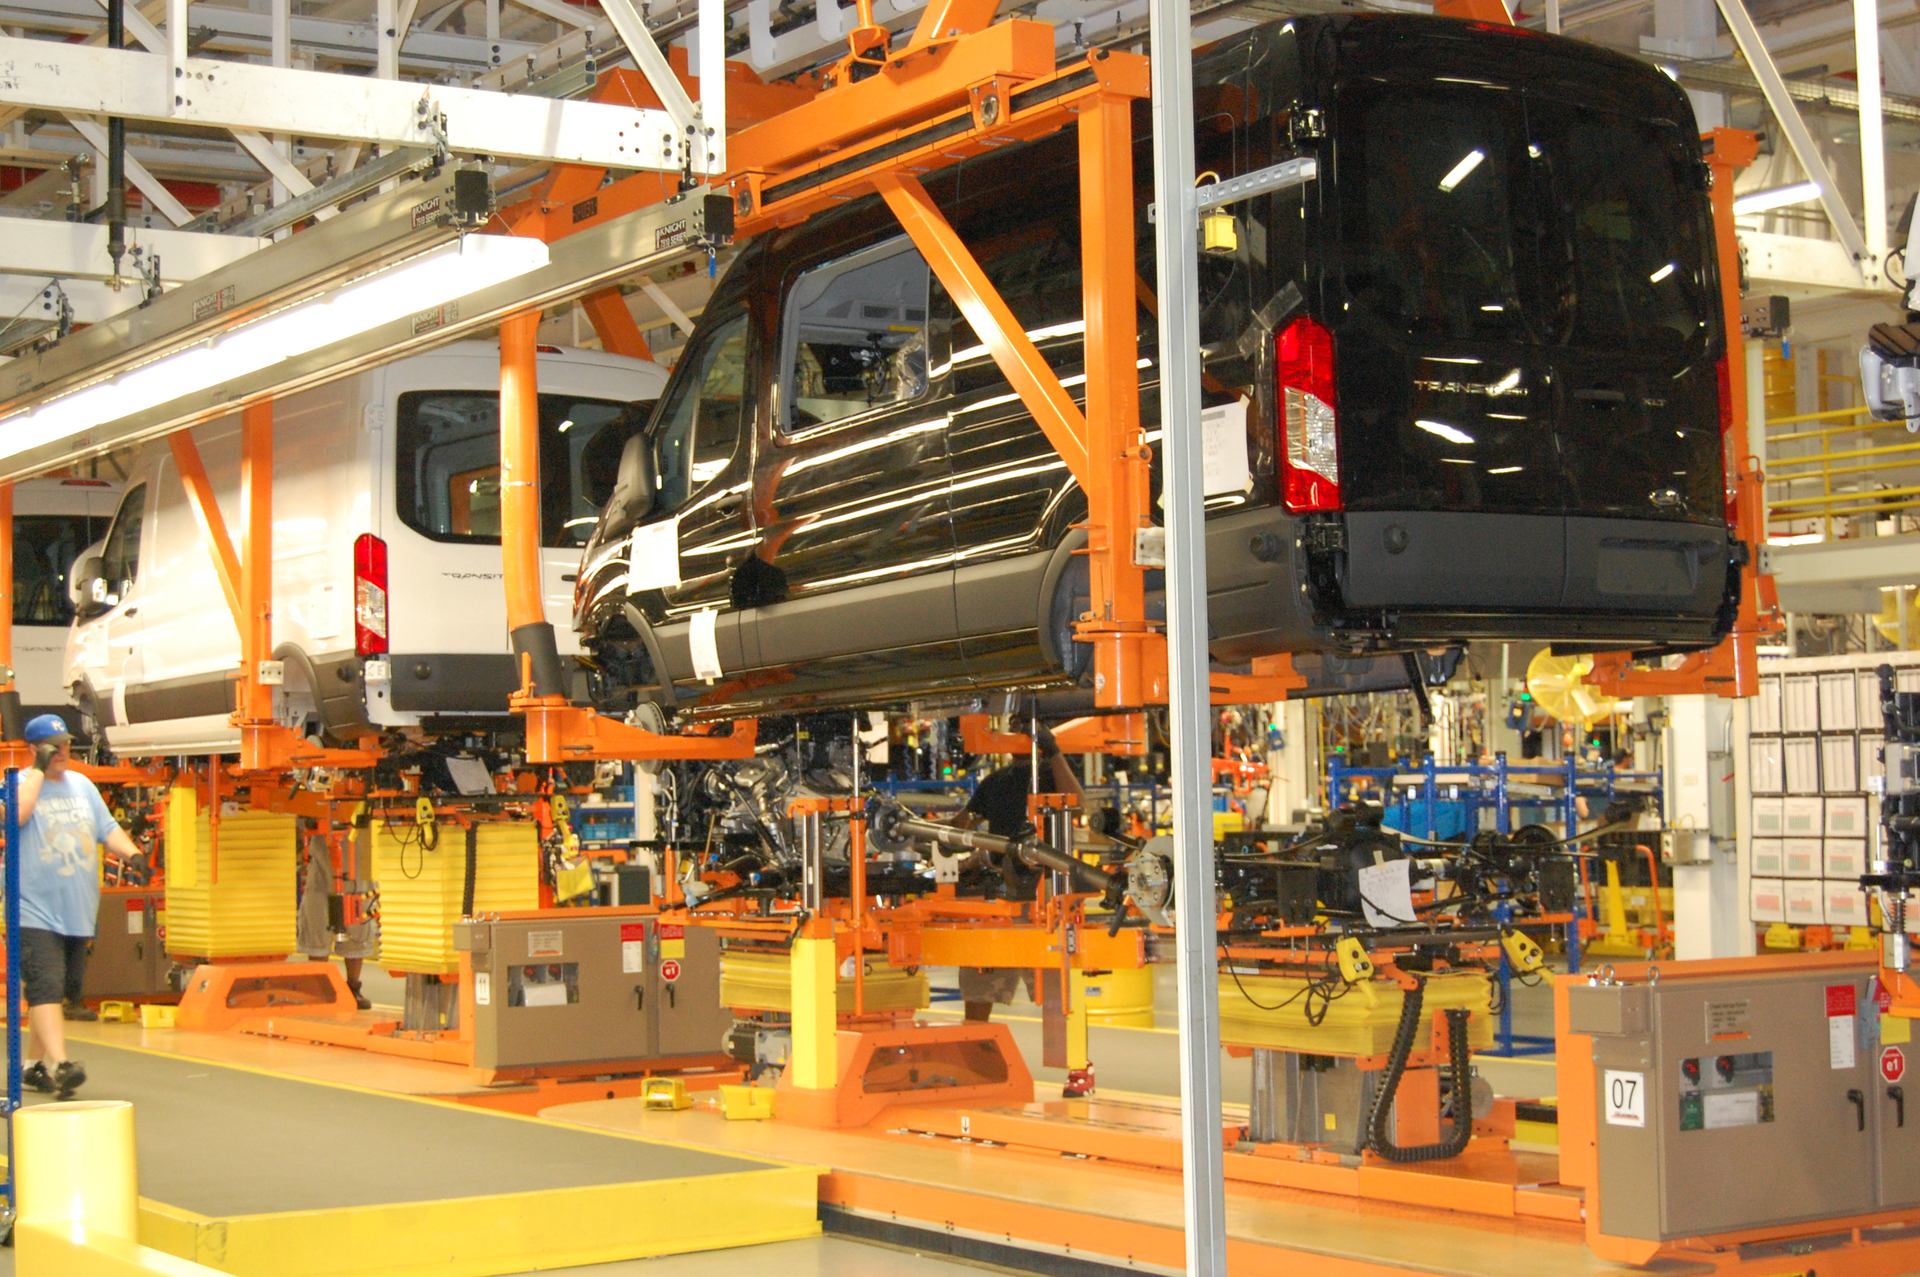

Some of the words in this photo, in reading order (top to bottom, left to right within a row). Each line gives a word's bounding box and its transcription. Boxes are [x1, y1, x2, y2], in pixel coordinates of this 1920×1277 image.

[415, 197, 440, 214] KNIGHT
[660, 219, 686, 236] KNIGHT
[1413, 380, 1503, 396] TRANS
[441, 571, 503, 580] TRANSIT
[1886, 1057, 1899, 1072] e1
[1612, 1078, 1637, 1110] 07
